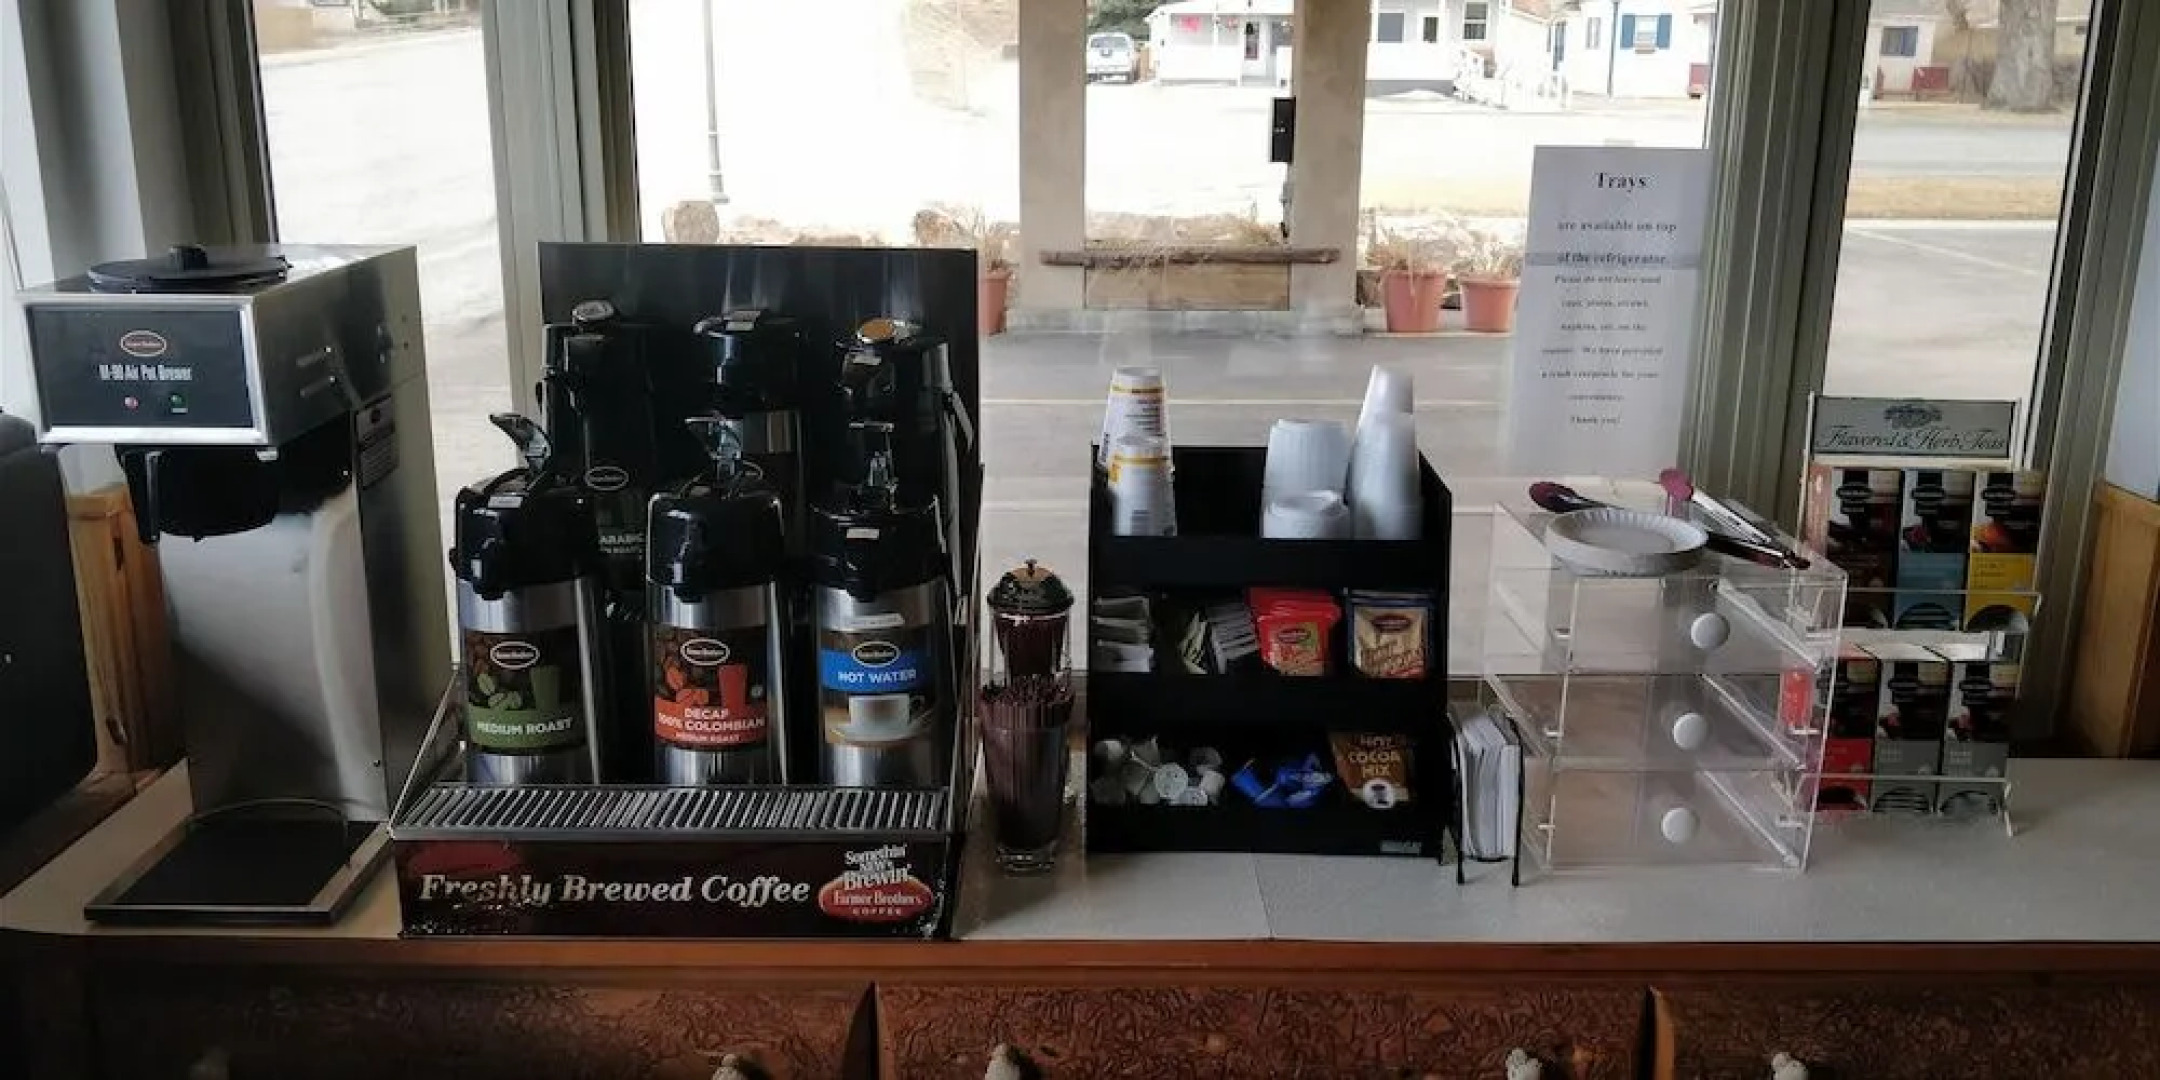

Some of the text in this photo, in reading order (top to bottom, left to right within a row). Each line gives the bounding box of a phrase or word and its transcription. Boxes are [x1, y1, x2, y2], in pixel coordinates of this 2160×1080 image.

[1594, 172, 1650, 193] Trays
[1556, 219, 1677, 233] are available on top
[1556, 252, 1570, 264] of
[1572, 252, 1589, 264] the
[837, 668, 917, 684] HOT WATER
[684, 707, 729, 720] DECAF
[475, 716, 573, 735] MEDIUM ROAST
[684, 717, 766, 732] COLOMBIAN
[1348, 750, 1401, 764] COCOA
[419, 873, 810, 908] Freshly Brewed Coffee
[832, 889, 873, 906] Farmer
